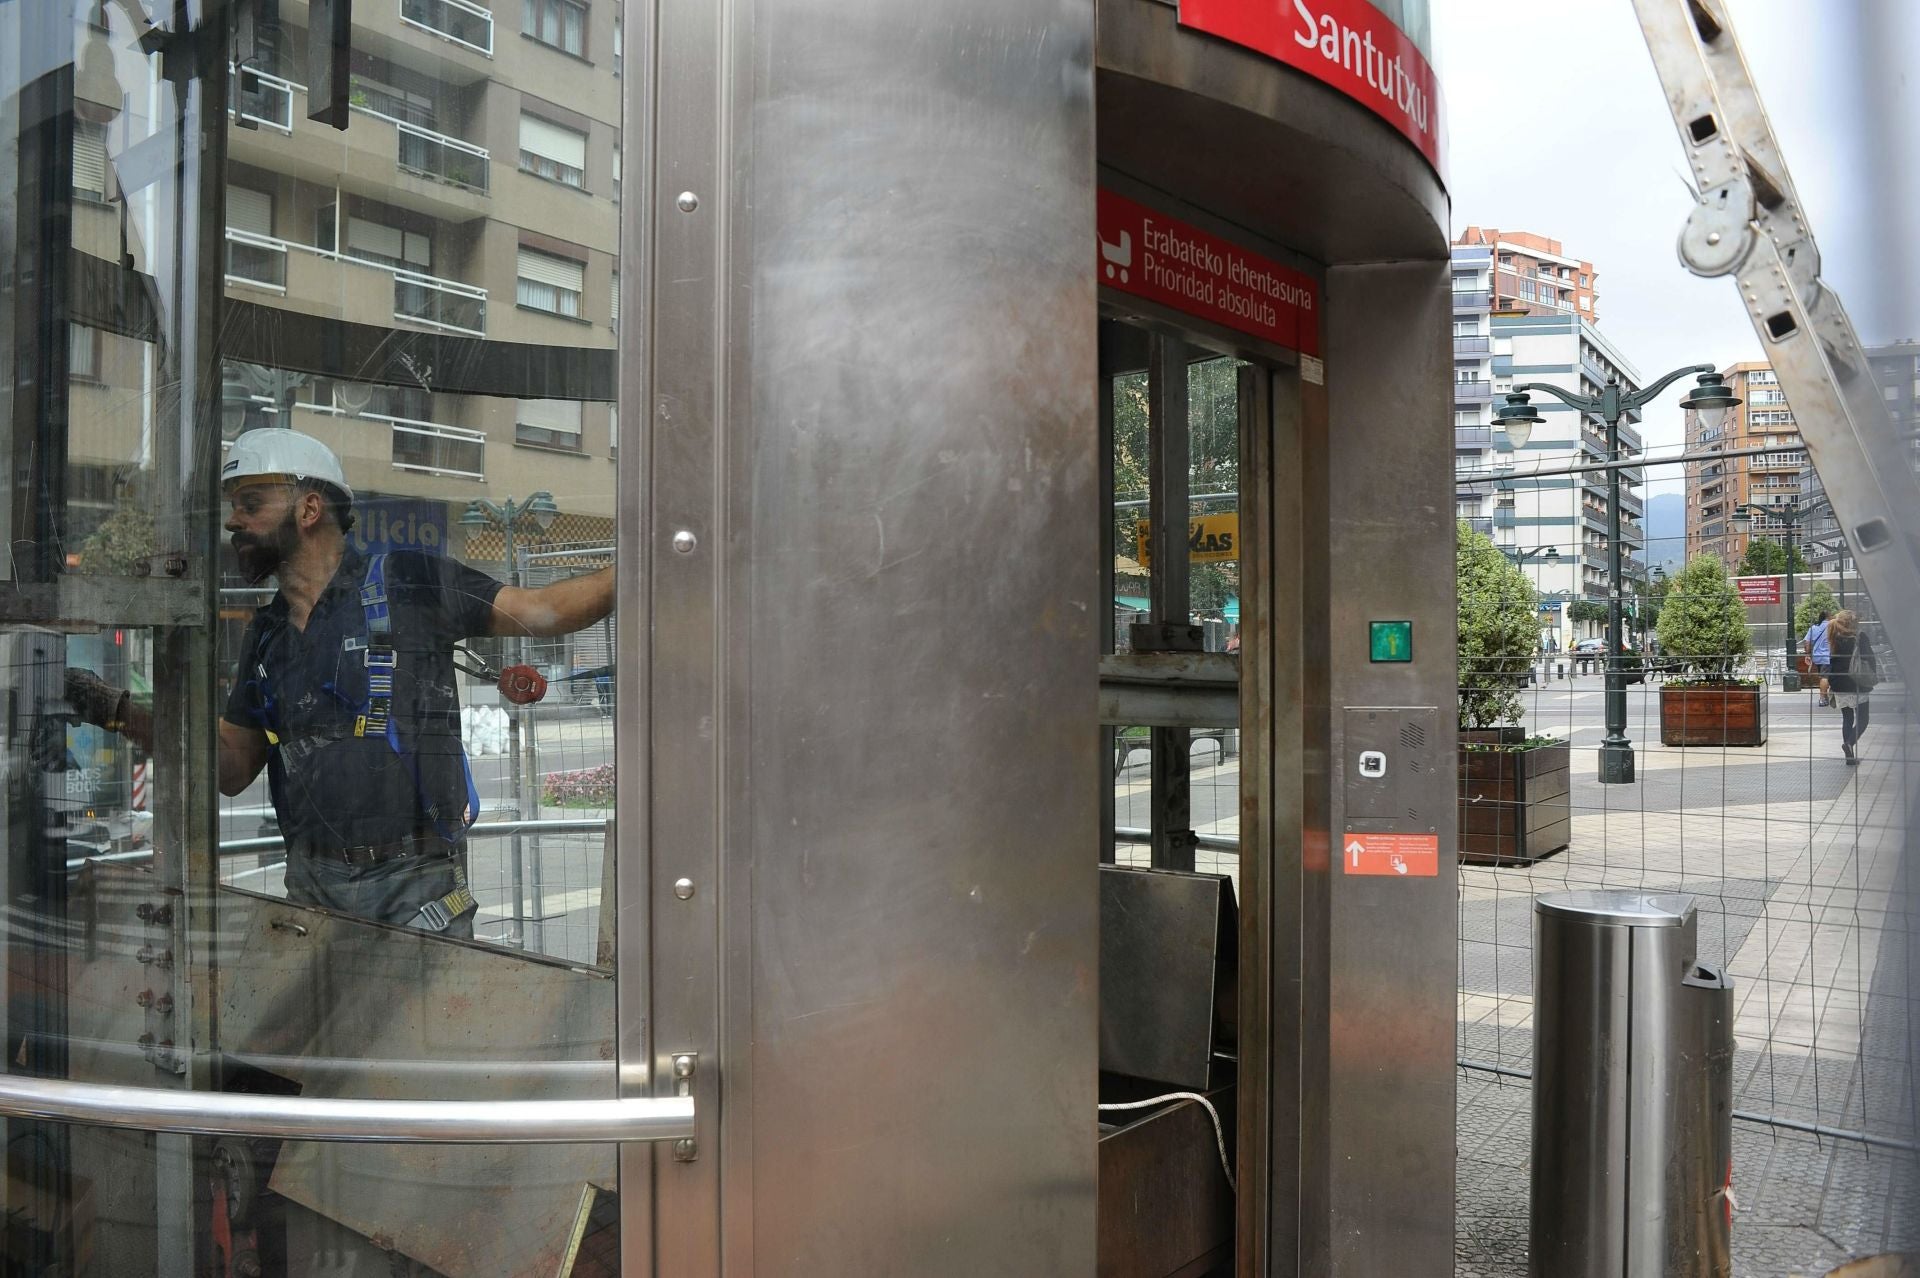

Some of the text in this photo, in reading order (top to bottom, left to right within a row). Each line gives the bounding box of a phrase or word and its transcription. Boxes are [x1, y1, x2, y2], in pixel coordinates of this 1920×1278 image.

[1293, 0, 1427, 134] Santutxu
[1143, 218, 1312, 311] Erabateko lehentasuna
[1144, 253, 1276, 327] Prioridad absoluta
